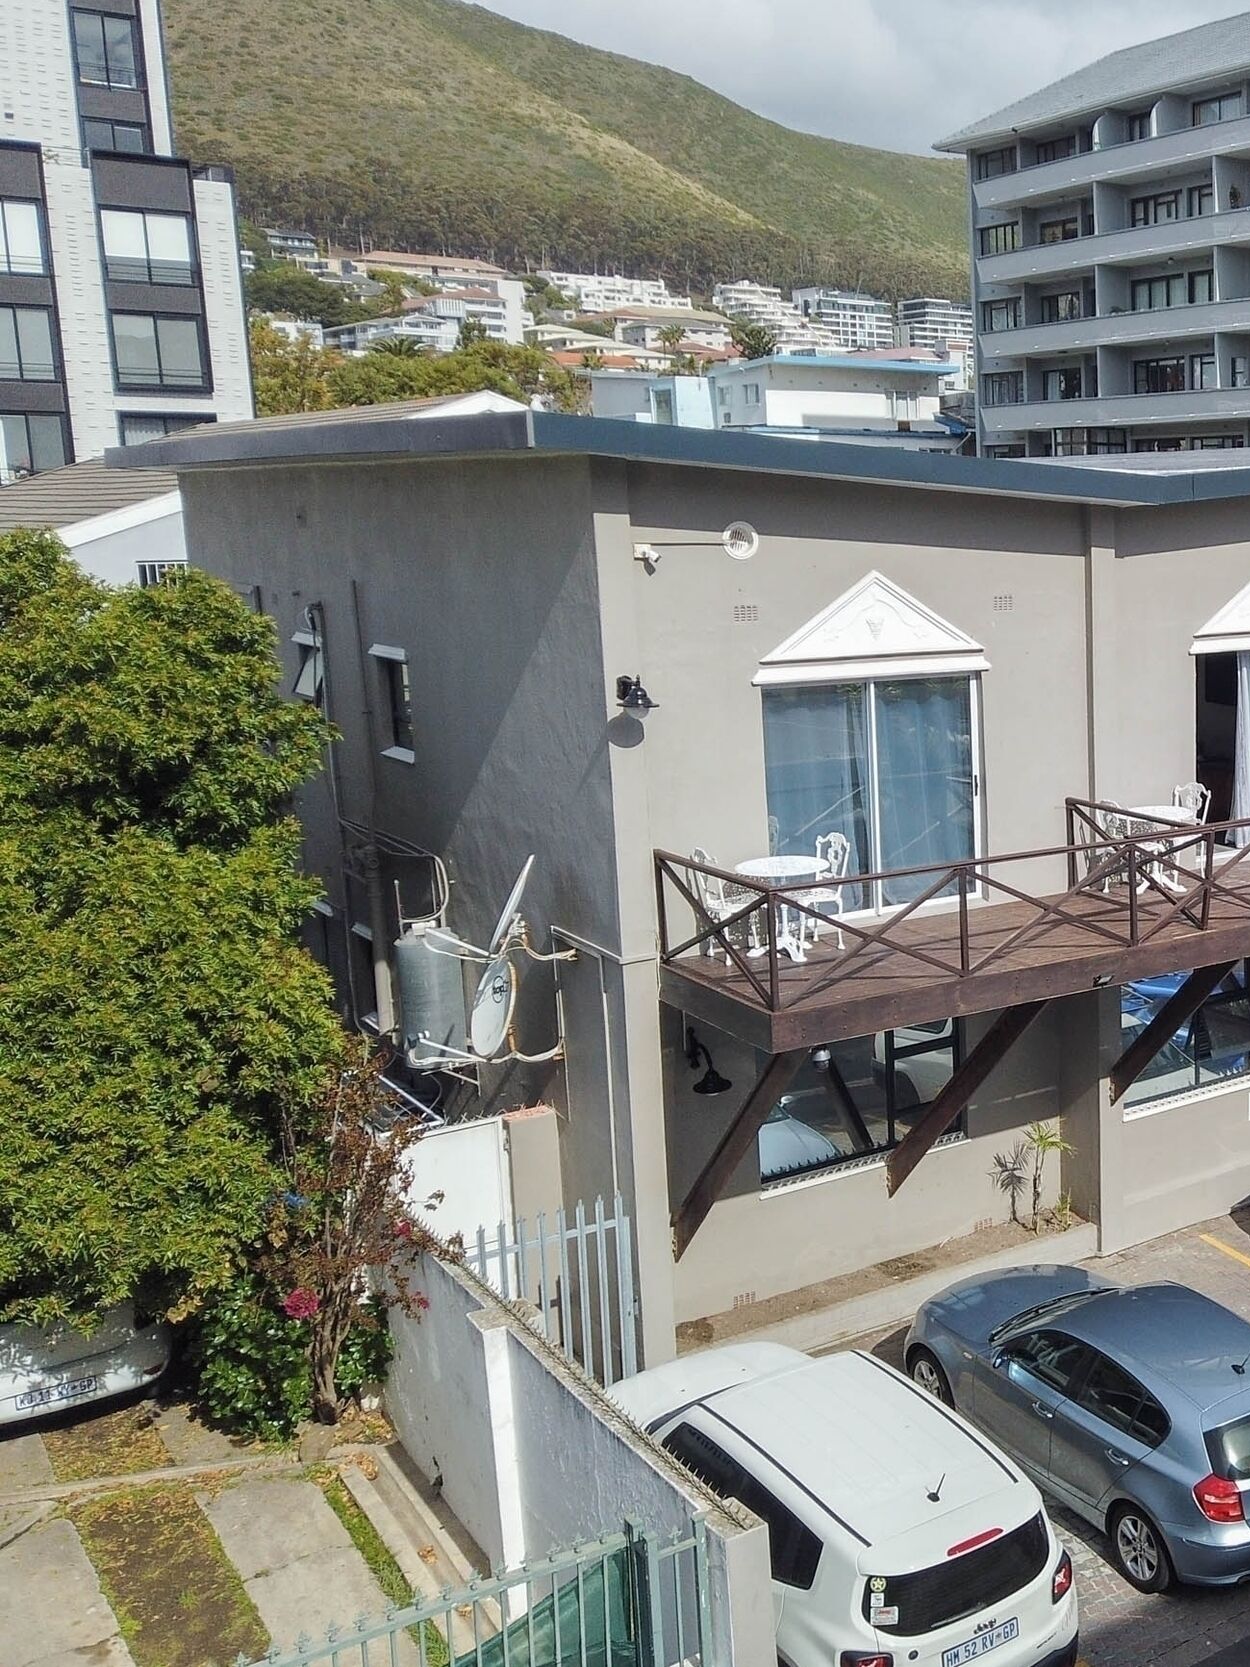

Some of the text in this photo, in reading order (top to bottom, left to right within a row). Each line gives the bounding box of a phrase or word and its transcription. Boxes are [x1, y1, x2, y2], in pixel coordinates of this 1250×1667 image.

[945, 1622, 1016, 1667] HM 52 RV GP
